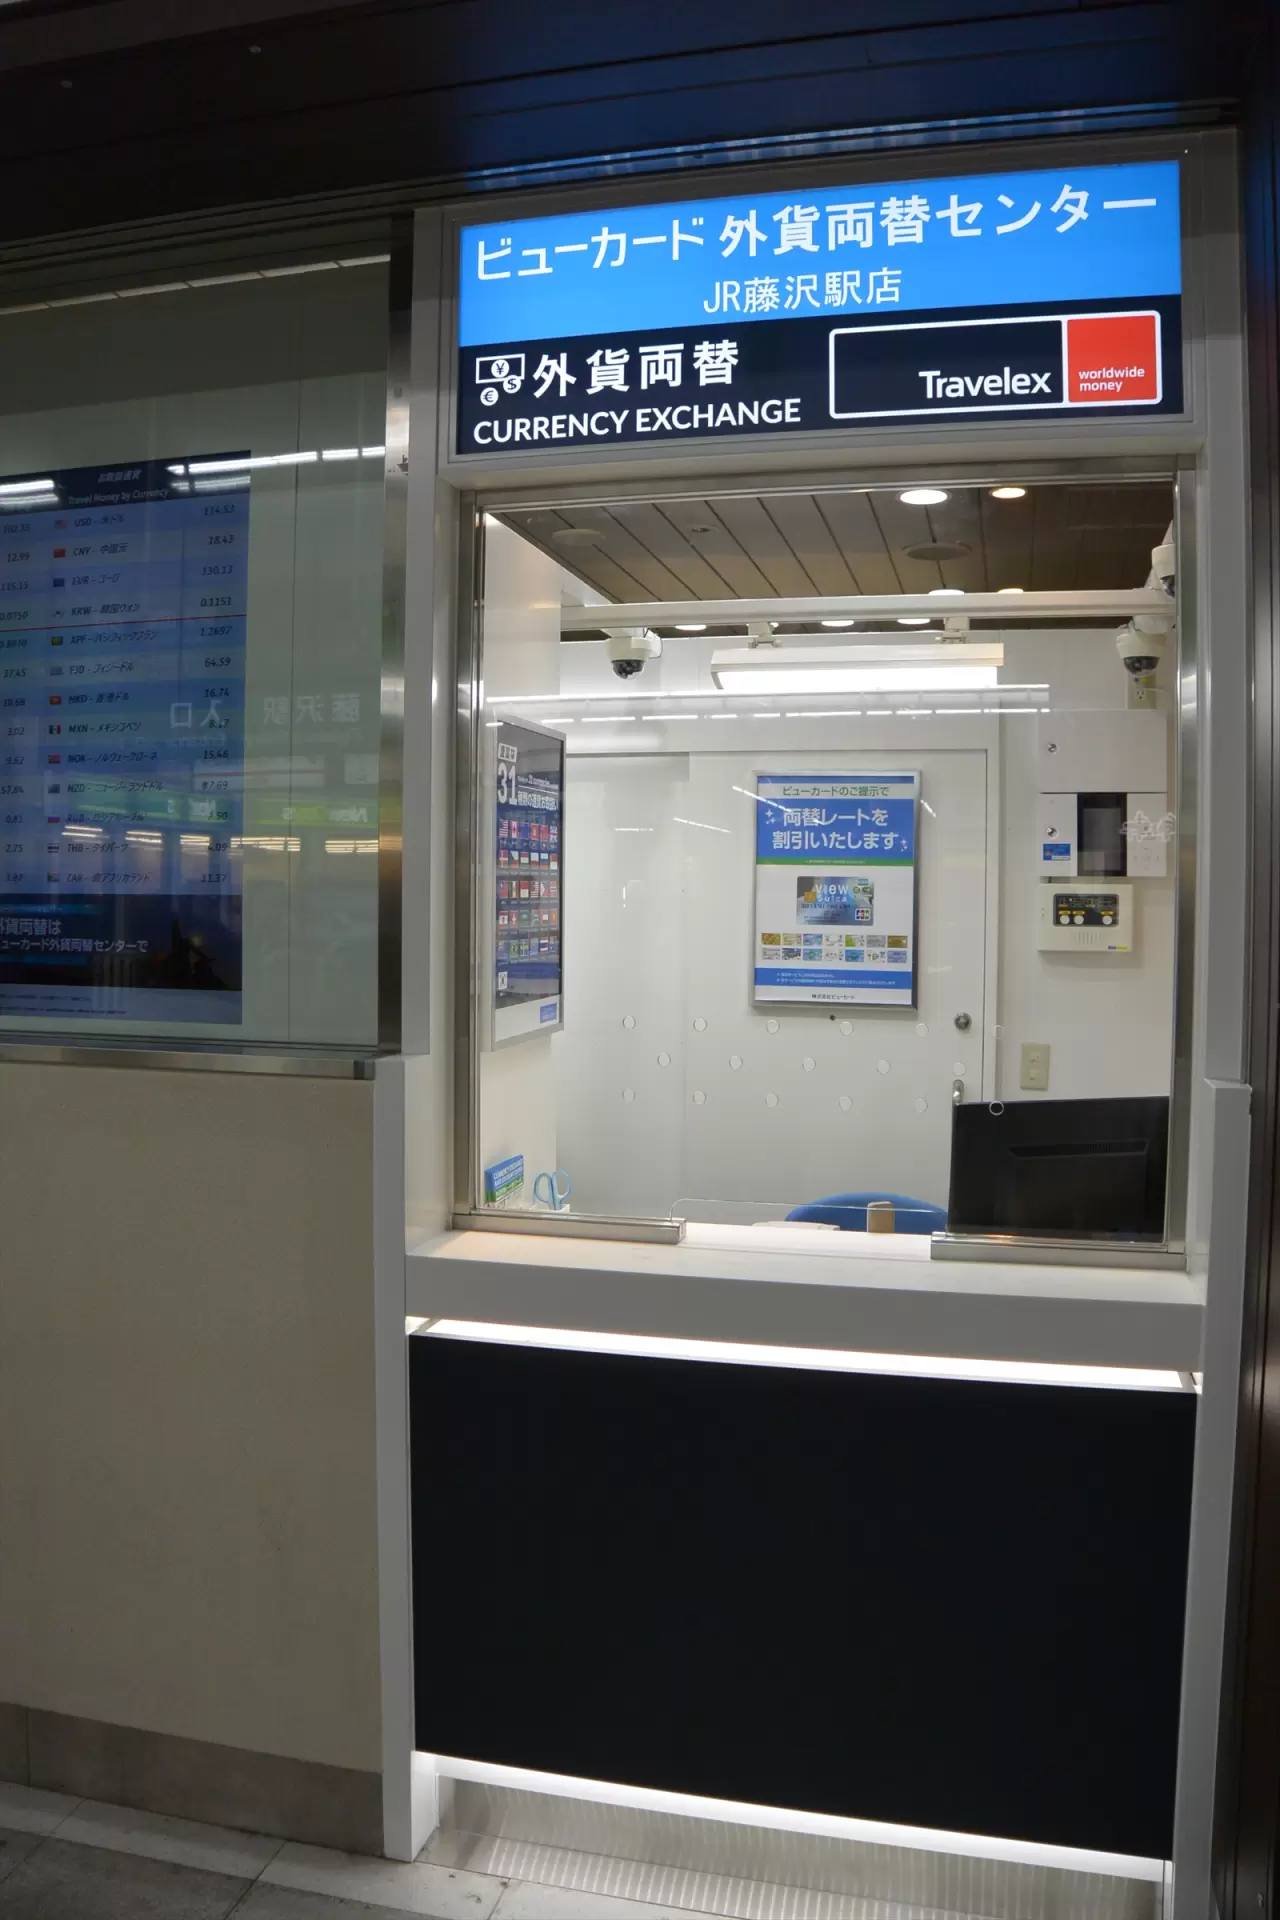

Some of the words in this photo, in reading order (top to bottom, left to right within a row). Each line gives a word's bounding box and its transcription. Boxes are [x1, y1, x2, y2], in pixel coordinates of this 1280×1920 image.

[477, 217, 704, 280] ビューカード
[719, 184, 1157, 258] 外貨両替センター
[703, 267, 902, 314] JR藤沢駅店
[533, 339, 739, 399] 外貨両替
[1078, 366, 1145, 380] worldwide
[918, 366, 1052, 399] Travelex
[1079, 380, 1123, 393] money
[473, 410, 629, 444] CURRENCY
[636, 398, 801, 432] EXCHANGE
[71, 606, 93, 617] KRW
[204, 657, 232, 668] 64.59
[68, 723, 88, 734] MXN
[498, 762, 517, 805] 31
[782, 784, 890, 797] ビューカードのご提示で
[783, 808, 889, 827] 両替レートを
[772, 830, 899, 850] 割引いたします
[0, 918, 62, 936] 貨両替は
[0, 938, 149, 953] ューカード外貨両替センターで
